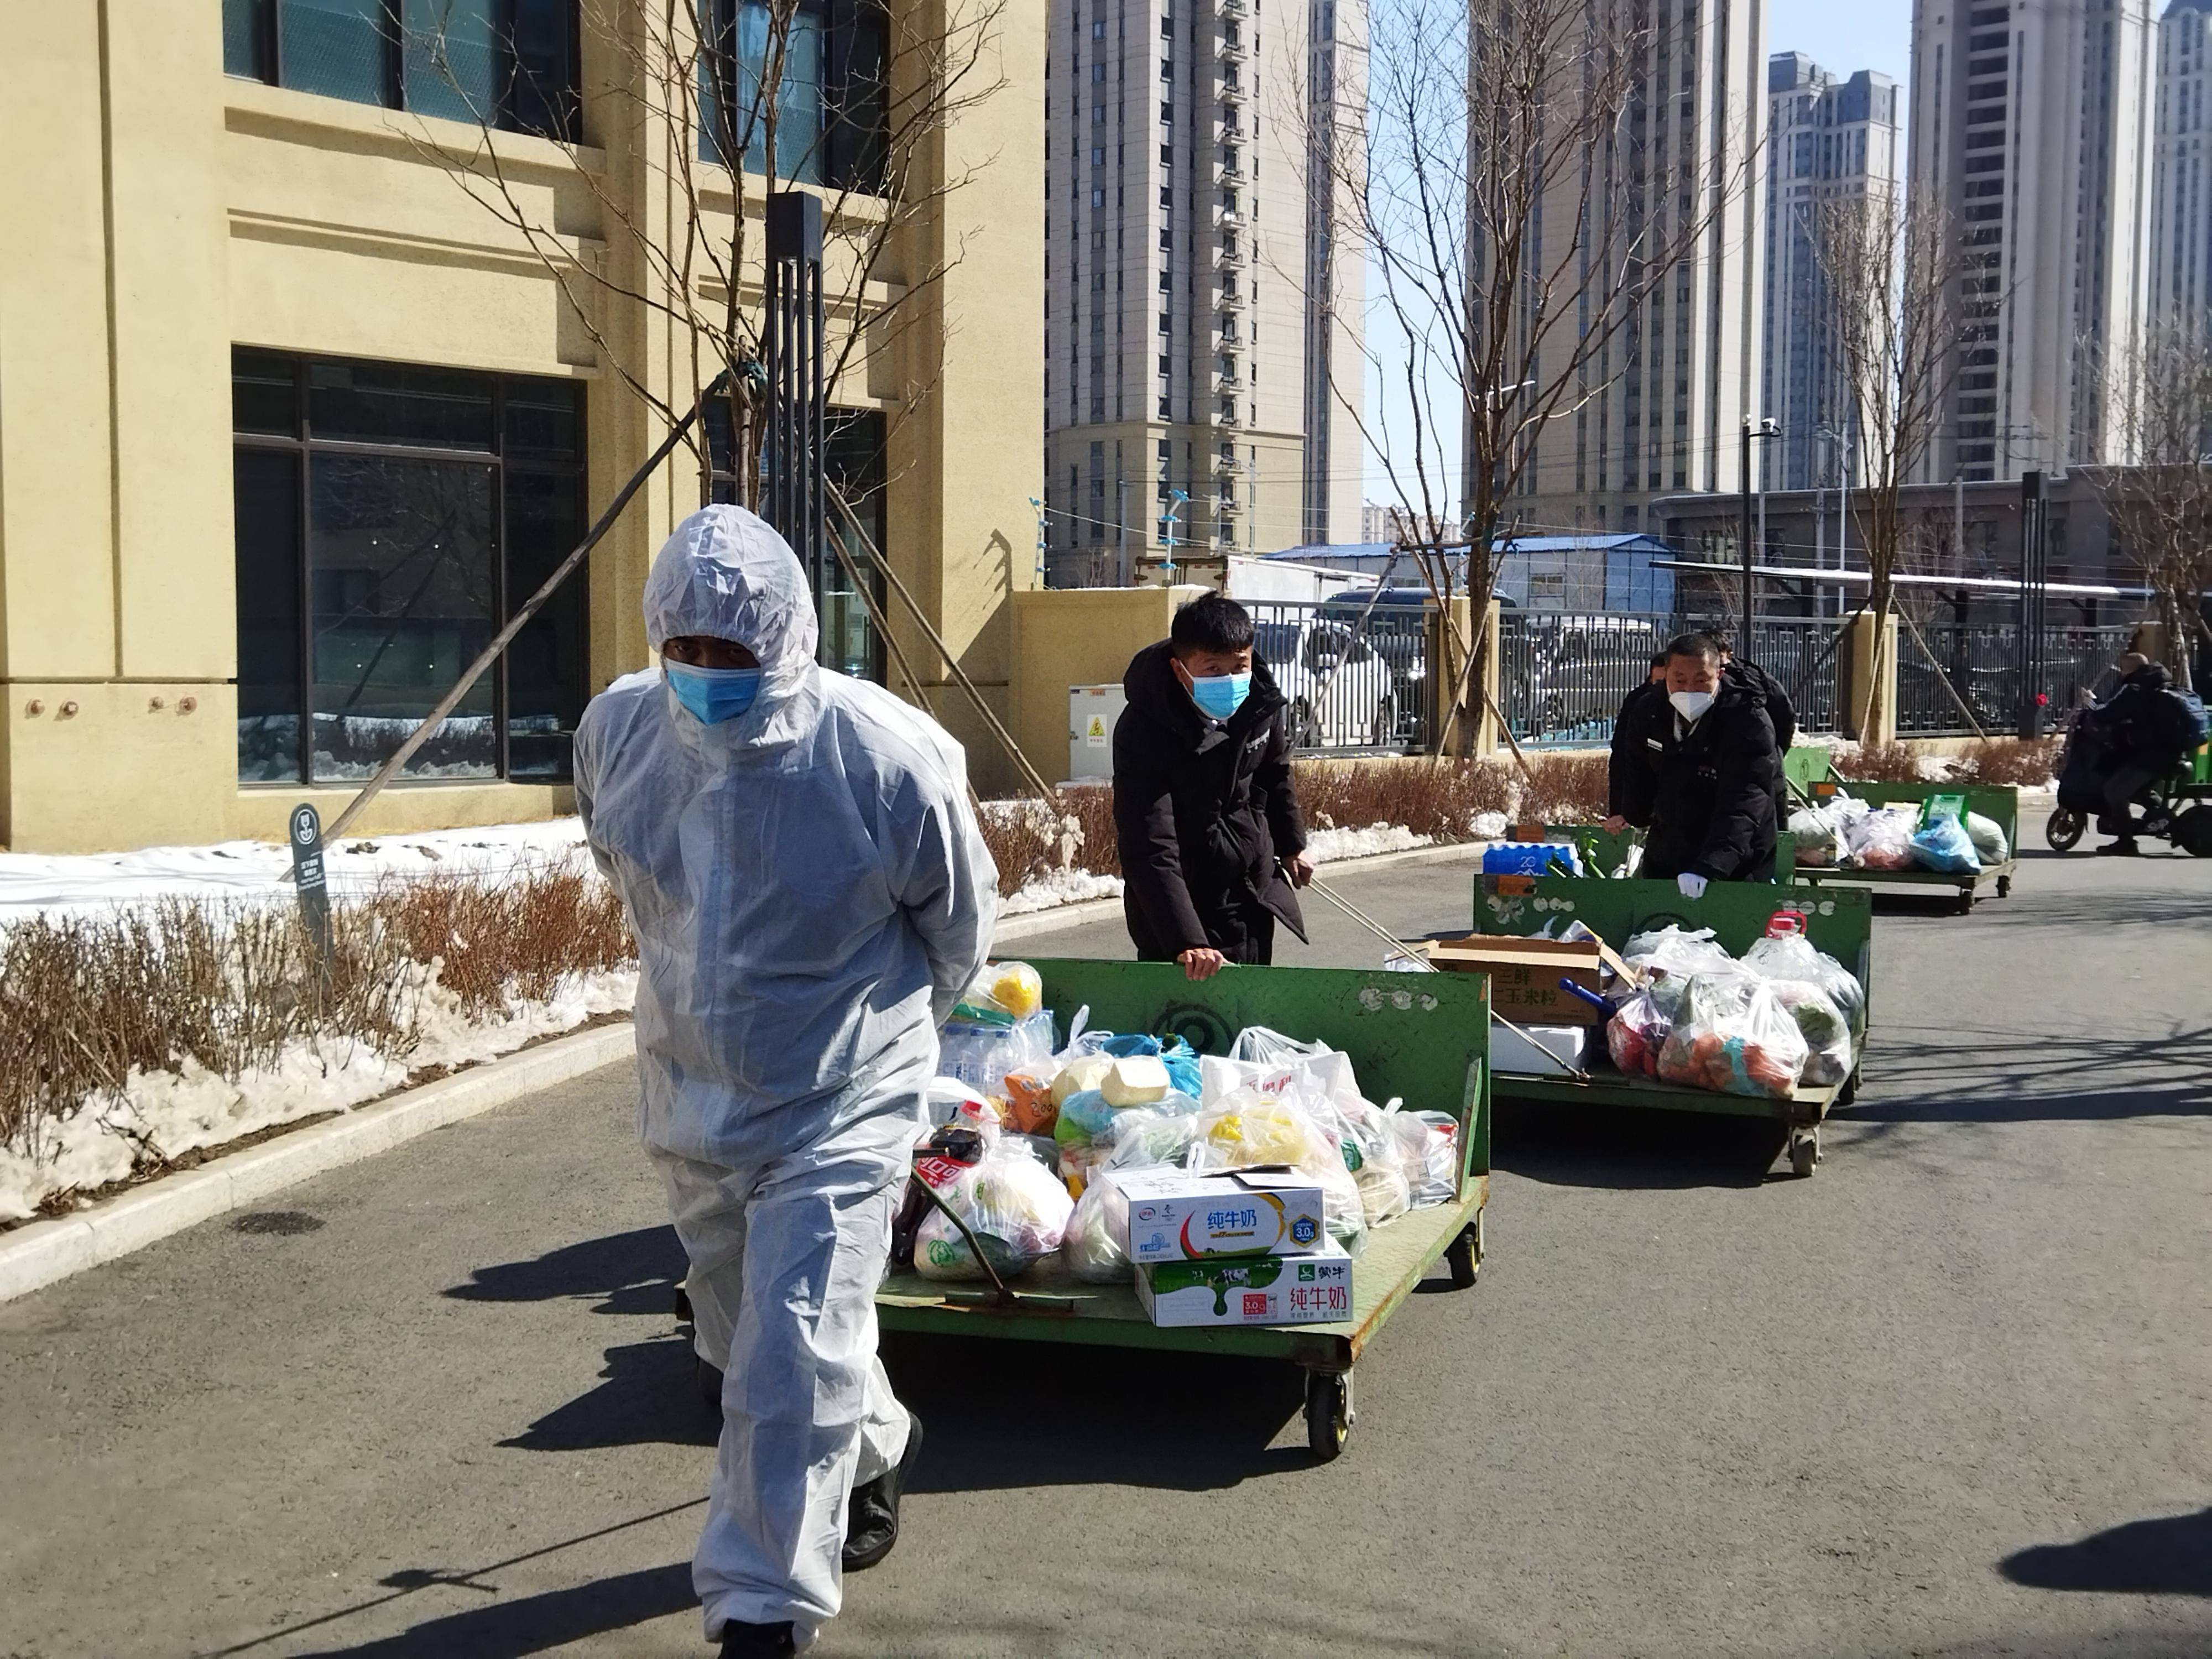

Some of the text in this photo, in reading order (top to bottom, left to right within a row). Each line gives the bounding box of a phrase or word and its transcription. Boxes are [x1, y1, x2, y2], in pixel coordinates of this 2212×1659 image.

[1207, 1209, 1257, 1229] 纯牛奶
[1318, 1266, 1345, 1279] 蒙牛
[1290, 1286, 1347, 1311] 纯牛奶
